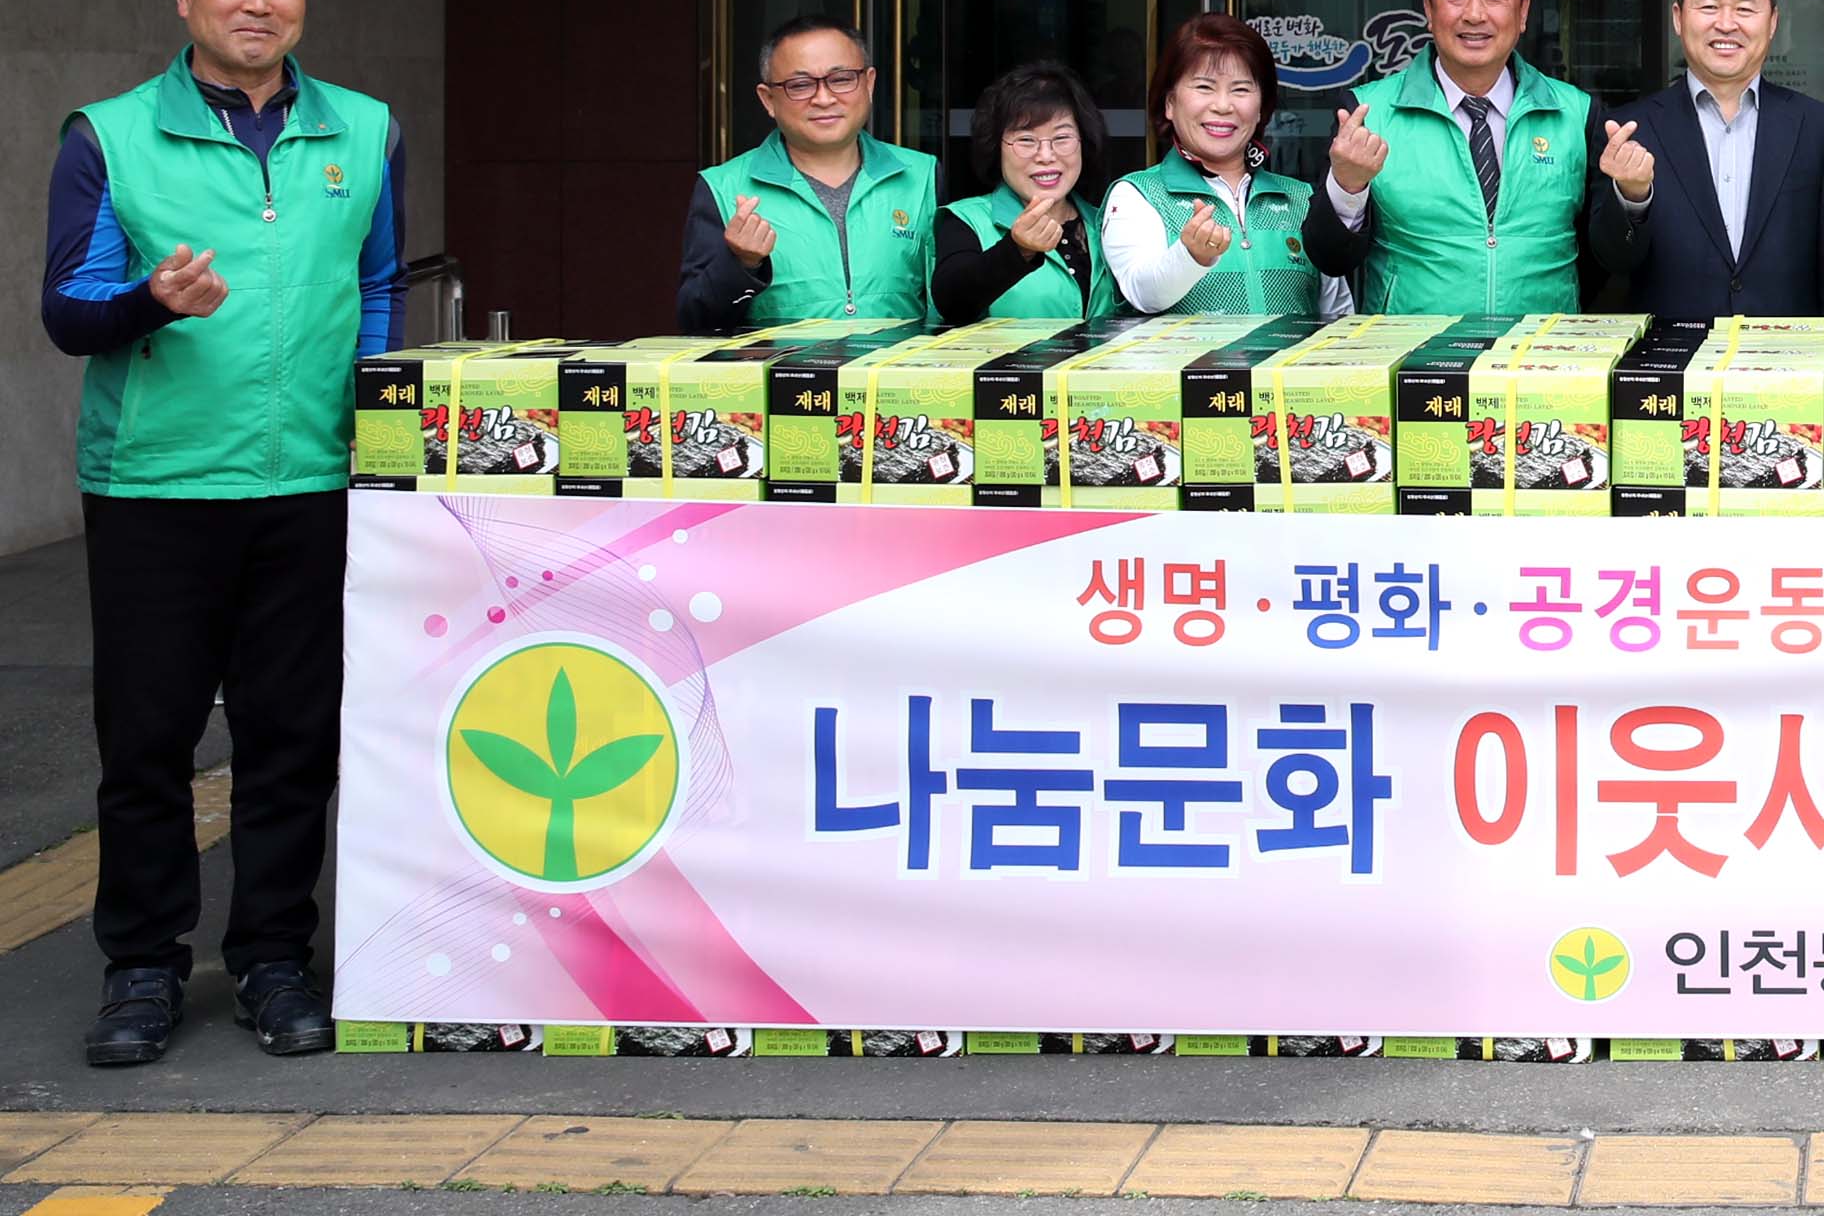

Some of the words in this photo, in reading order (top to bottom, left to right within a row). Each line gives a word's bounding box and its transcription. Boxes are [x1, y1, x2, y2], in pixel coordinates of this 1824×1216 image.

[1286, 14, 1321, 36] 변화
[1306, 38, 1347, 63] 행복한
[379, 384, 416, 405] 재래
[582, 385, 619, 408] 재래
[632, 386, 655, 400] 백제
[795, 390, 831, 412] 재래
[1208, 391, 1245, 413] 재래
[1476, 396, 1499, 410] 백제
[1000, 393, 1037, 416] 재래
[1424, 395, 1462, 418] 재래
[1639, 394, 1677, 416] 재래
[814, 695, 1392, 874] 나눔문화
